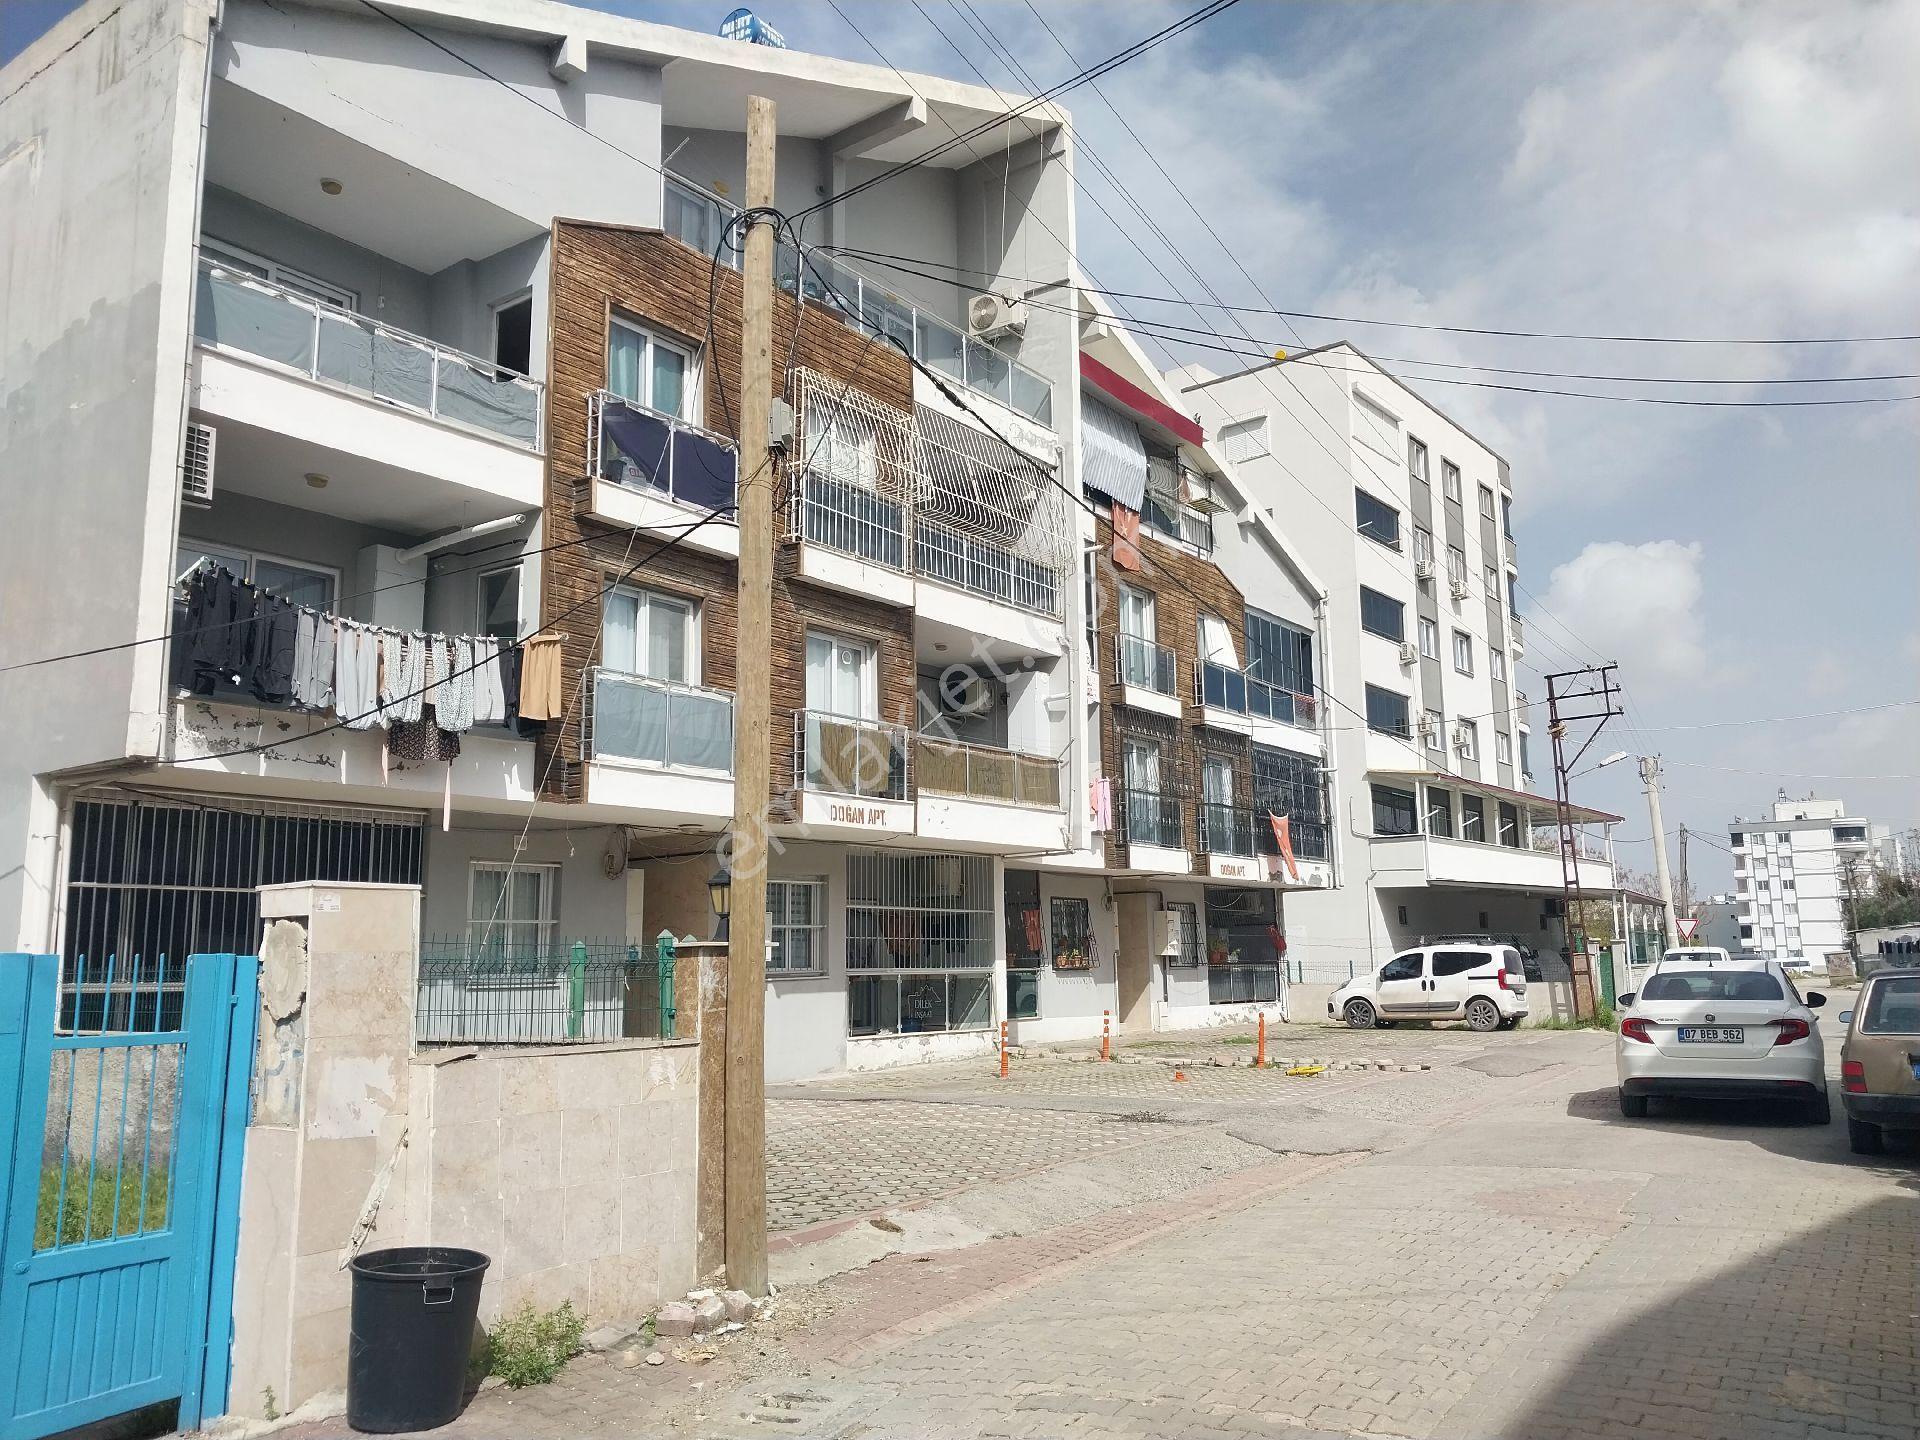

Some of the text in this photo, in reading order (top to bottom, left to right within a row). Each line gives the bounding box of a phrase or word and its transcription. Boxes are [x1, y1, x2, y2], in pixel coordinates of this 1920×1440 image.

[830, 804, 886, 826] DOĞAN APT.
[1685, 1029, 1741, 1039] 07 BEB 962
